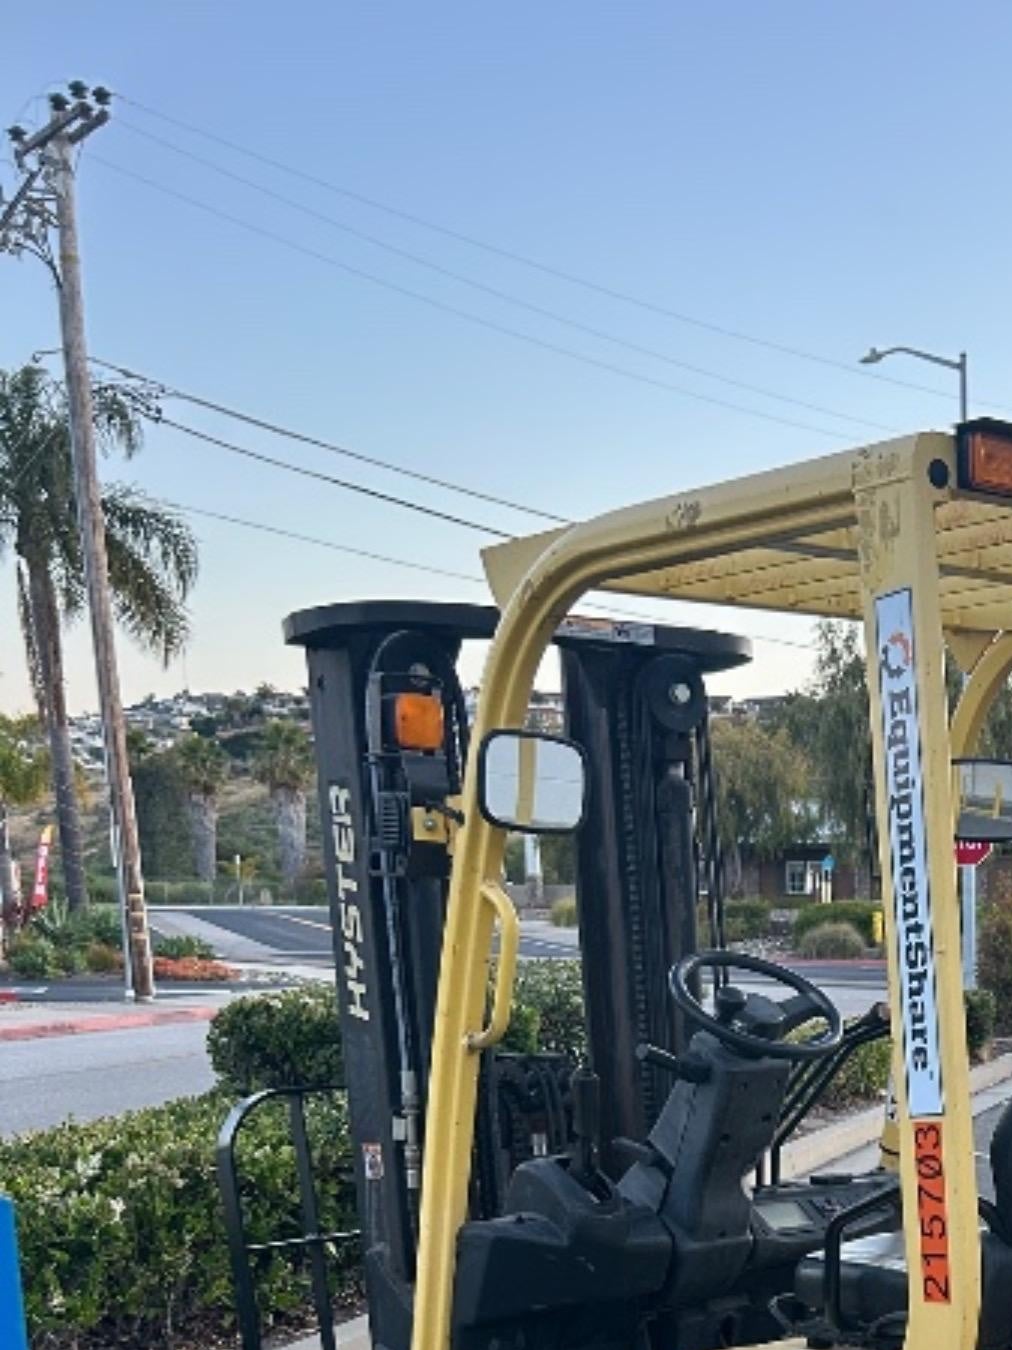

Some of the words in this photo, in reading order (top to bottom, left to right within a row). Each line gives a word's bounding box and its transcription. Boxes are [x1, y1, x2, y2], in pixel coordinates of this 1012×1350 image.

[329, 784, 370, 1022] HYSTER
[887, 686, 929, 1072] EquipmentShare
[915, 1124, 949, 1299] 215703
